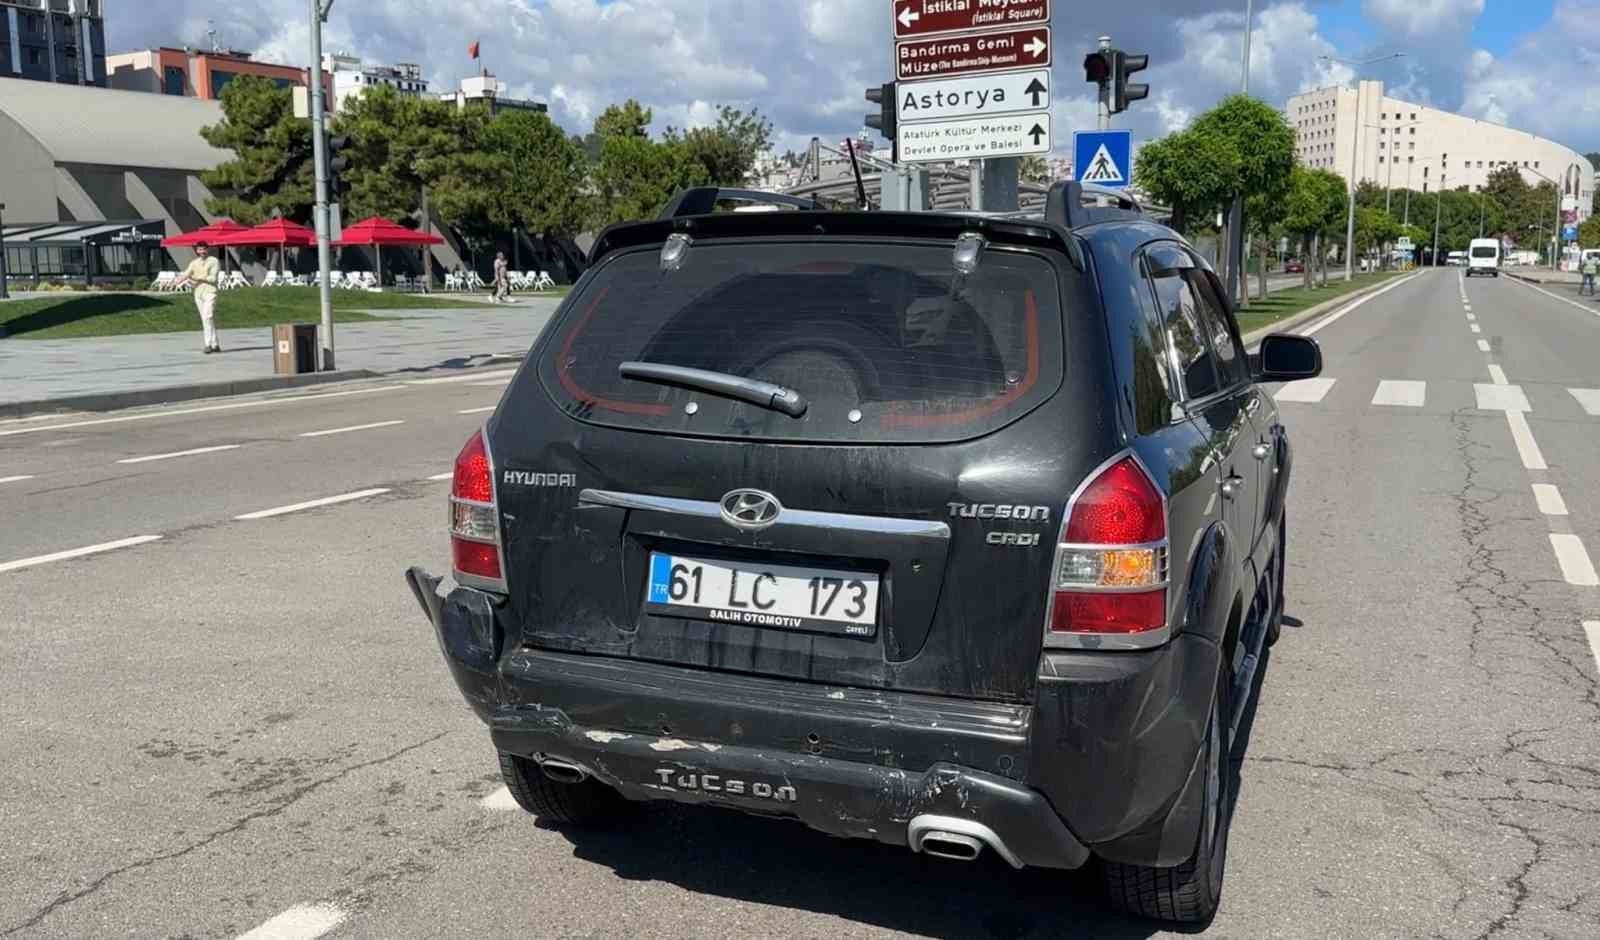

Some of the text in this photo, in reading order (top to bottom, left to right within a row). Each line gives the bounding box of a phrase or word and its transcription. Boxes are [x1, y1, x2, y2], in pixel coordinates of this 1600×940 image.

[1008, 6, 1043, 20] Square)
[900, 37, 1015, 58] Bandırma Gemi
[901, 61, 938, 74] Müze
[902, 88, 1006, 111] Astorya
[904, 130, 940, 140] Atatürk
[945, 127, 977, 137] Kültür
[904, 140, 1022, 155] Devlet Opera ve Balesi
[503, 470, 576, 487] HYUNDAI
[947, 502, 1050, 521] TUCSON
[655, 563, 868, 618] TR 61 LC 173
